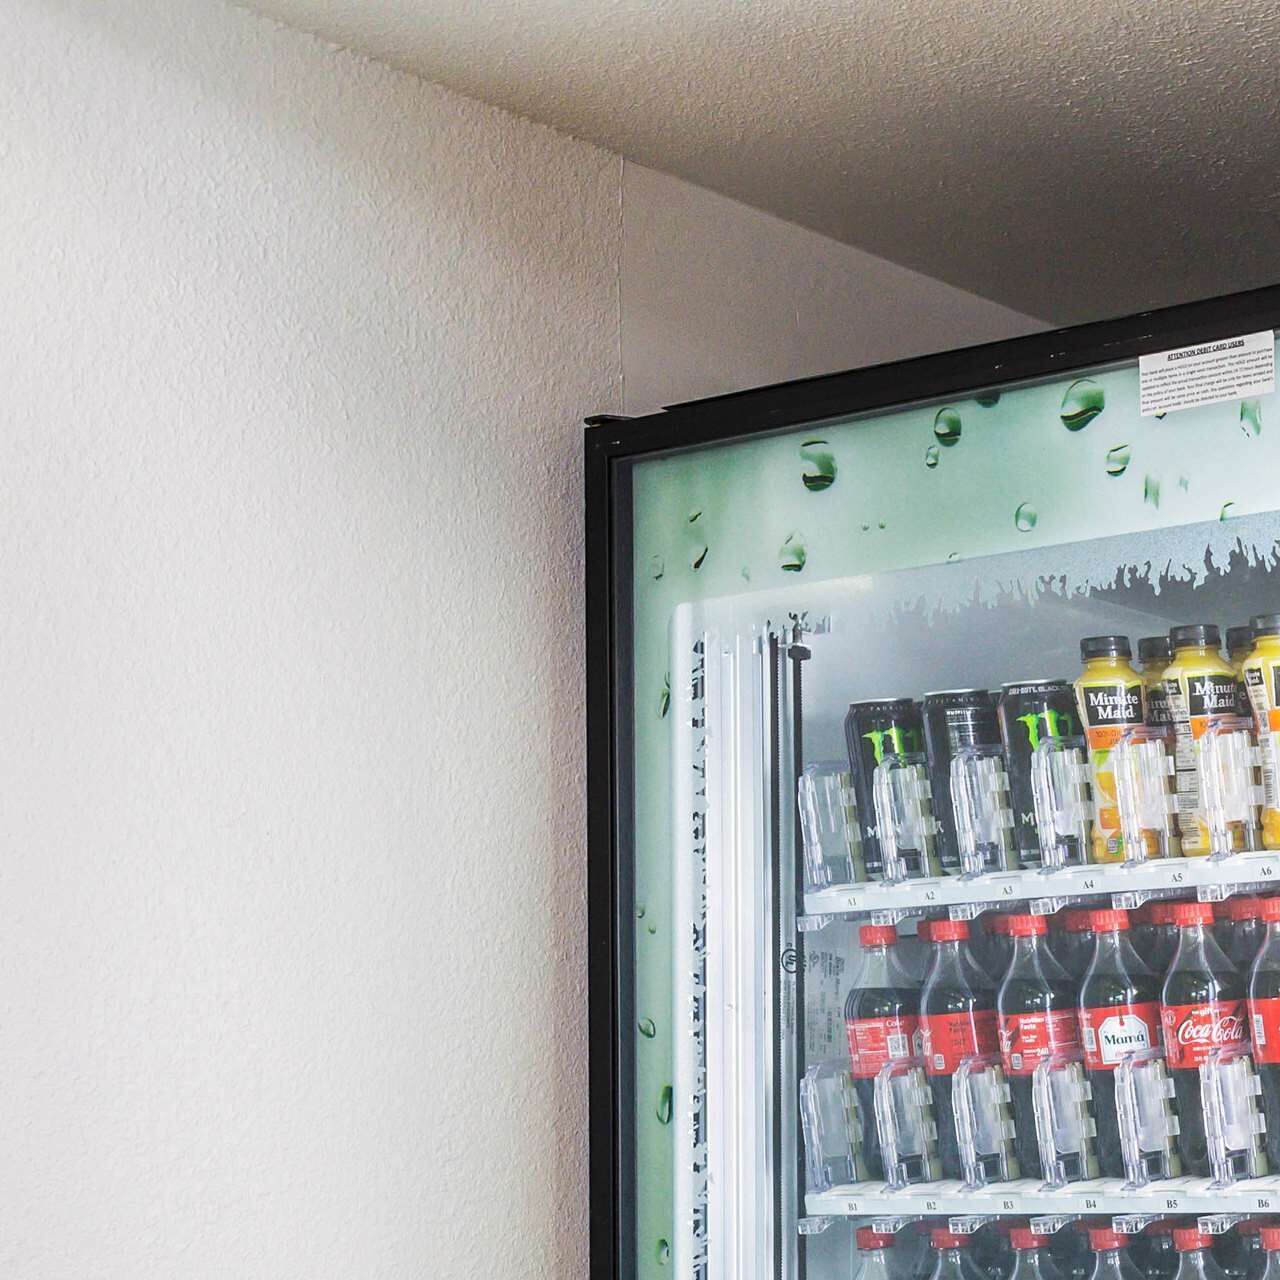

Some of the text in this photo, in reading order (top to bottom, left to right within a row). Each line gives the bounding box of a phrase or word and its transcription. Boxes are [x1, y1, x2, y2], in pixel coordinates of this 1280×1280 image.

[1089, 692, 1138, 706] Minute
[1098, 704, 1136, 719] Maid
[1082, 880, 1094, 889] A4
[1177, 1016, 1242, 1043] Coca-Cola
[1103, 1030, 1145, 1048] Mamá
